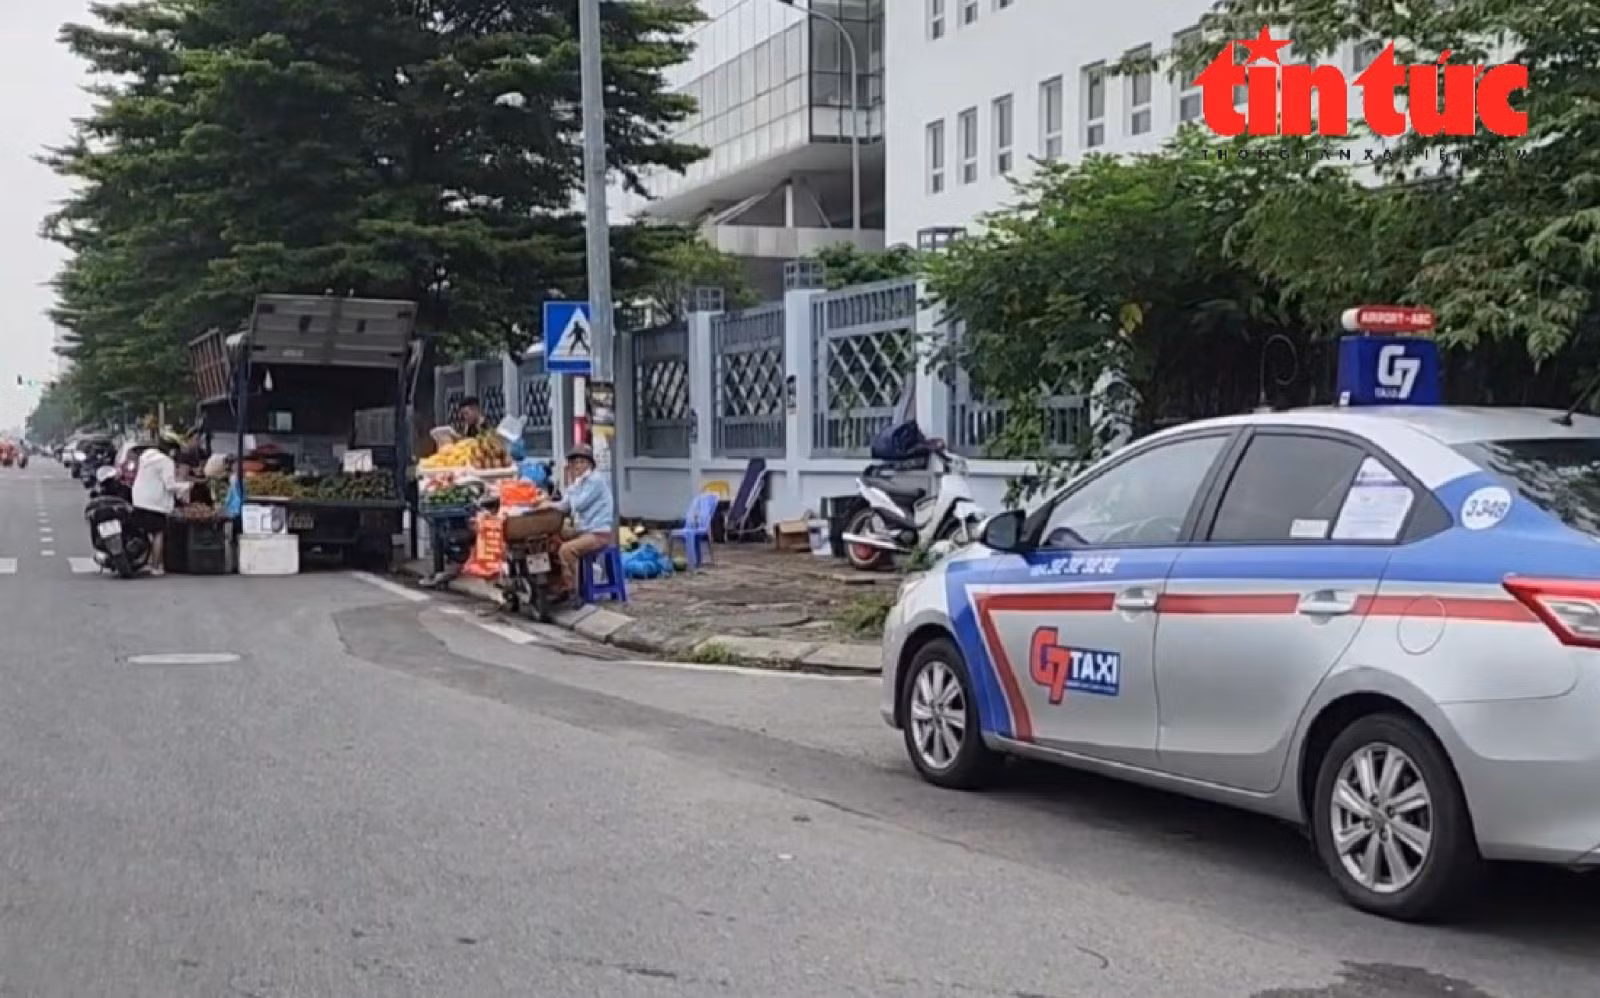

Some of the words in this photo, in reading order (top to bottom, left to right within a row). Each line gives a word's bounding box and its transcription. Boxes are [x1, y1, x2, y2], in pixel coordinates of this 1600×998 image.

[1378, 345, 1421, 400] G7
[1029, 625, 1072, 704] G7
[1070, 651, 1119, 684] TAXI
